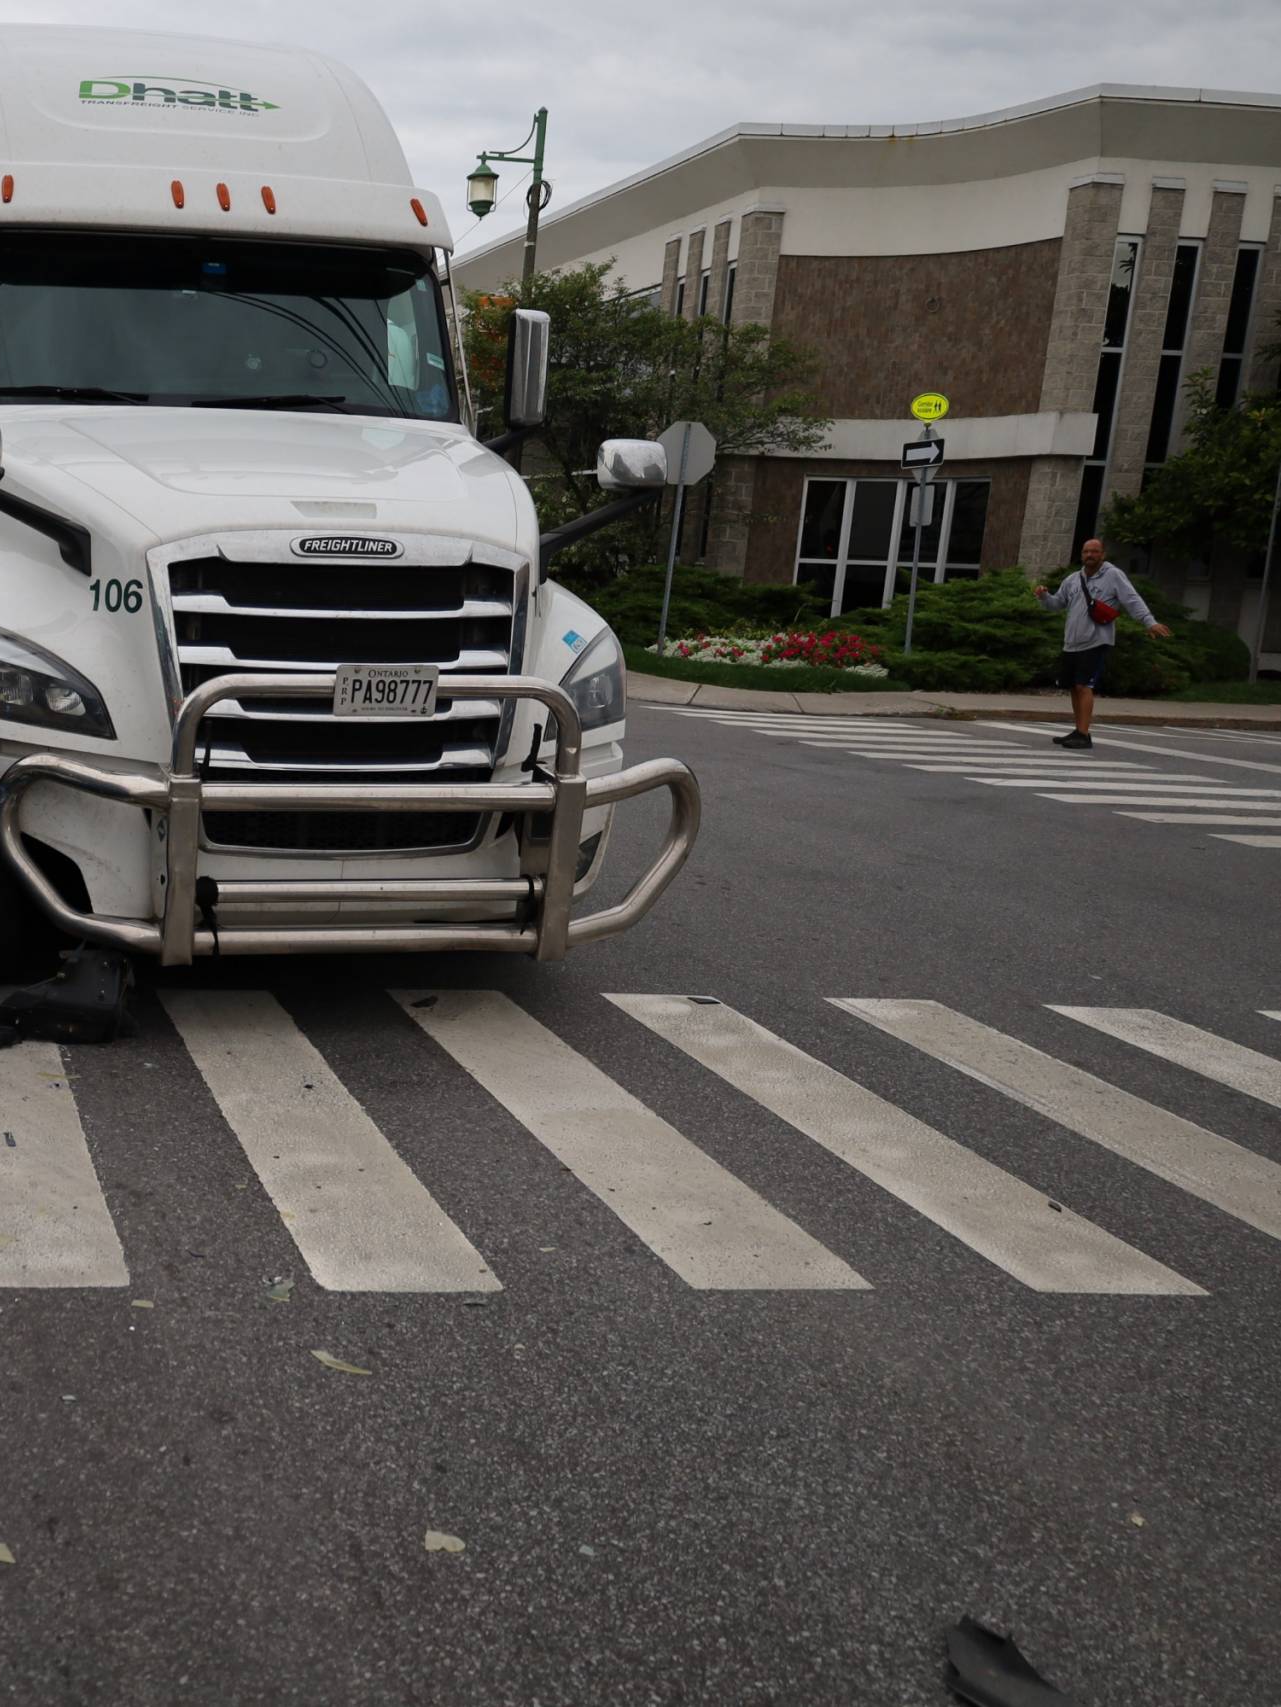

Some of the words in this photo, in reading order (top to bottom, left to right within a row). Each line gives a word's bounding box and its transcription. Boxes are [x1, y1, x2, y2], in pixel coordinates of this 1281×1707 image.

[79, 80, 258, 112] Dhatt
[304, 540, 393, 553] FREIGHTLINER
[90, 579, 143, 613] 106
[368, 669, 408, 679] ONTARIO
[351, 679, 433, 705] PA98777
